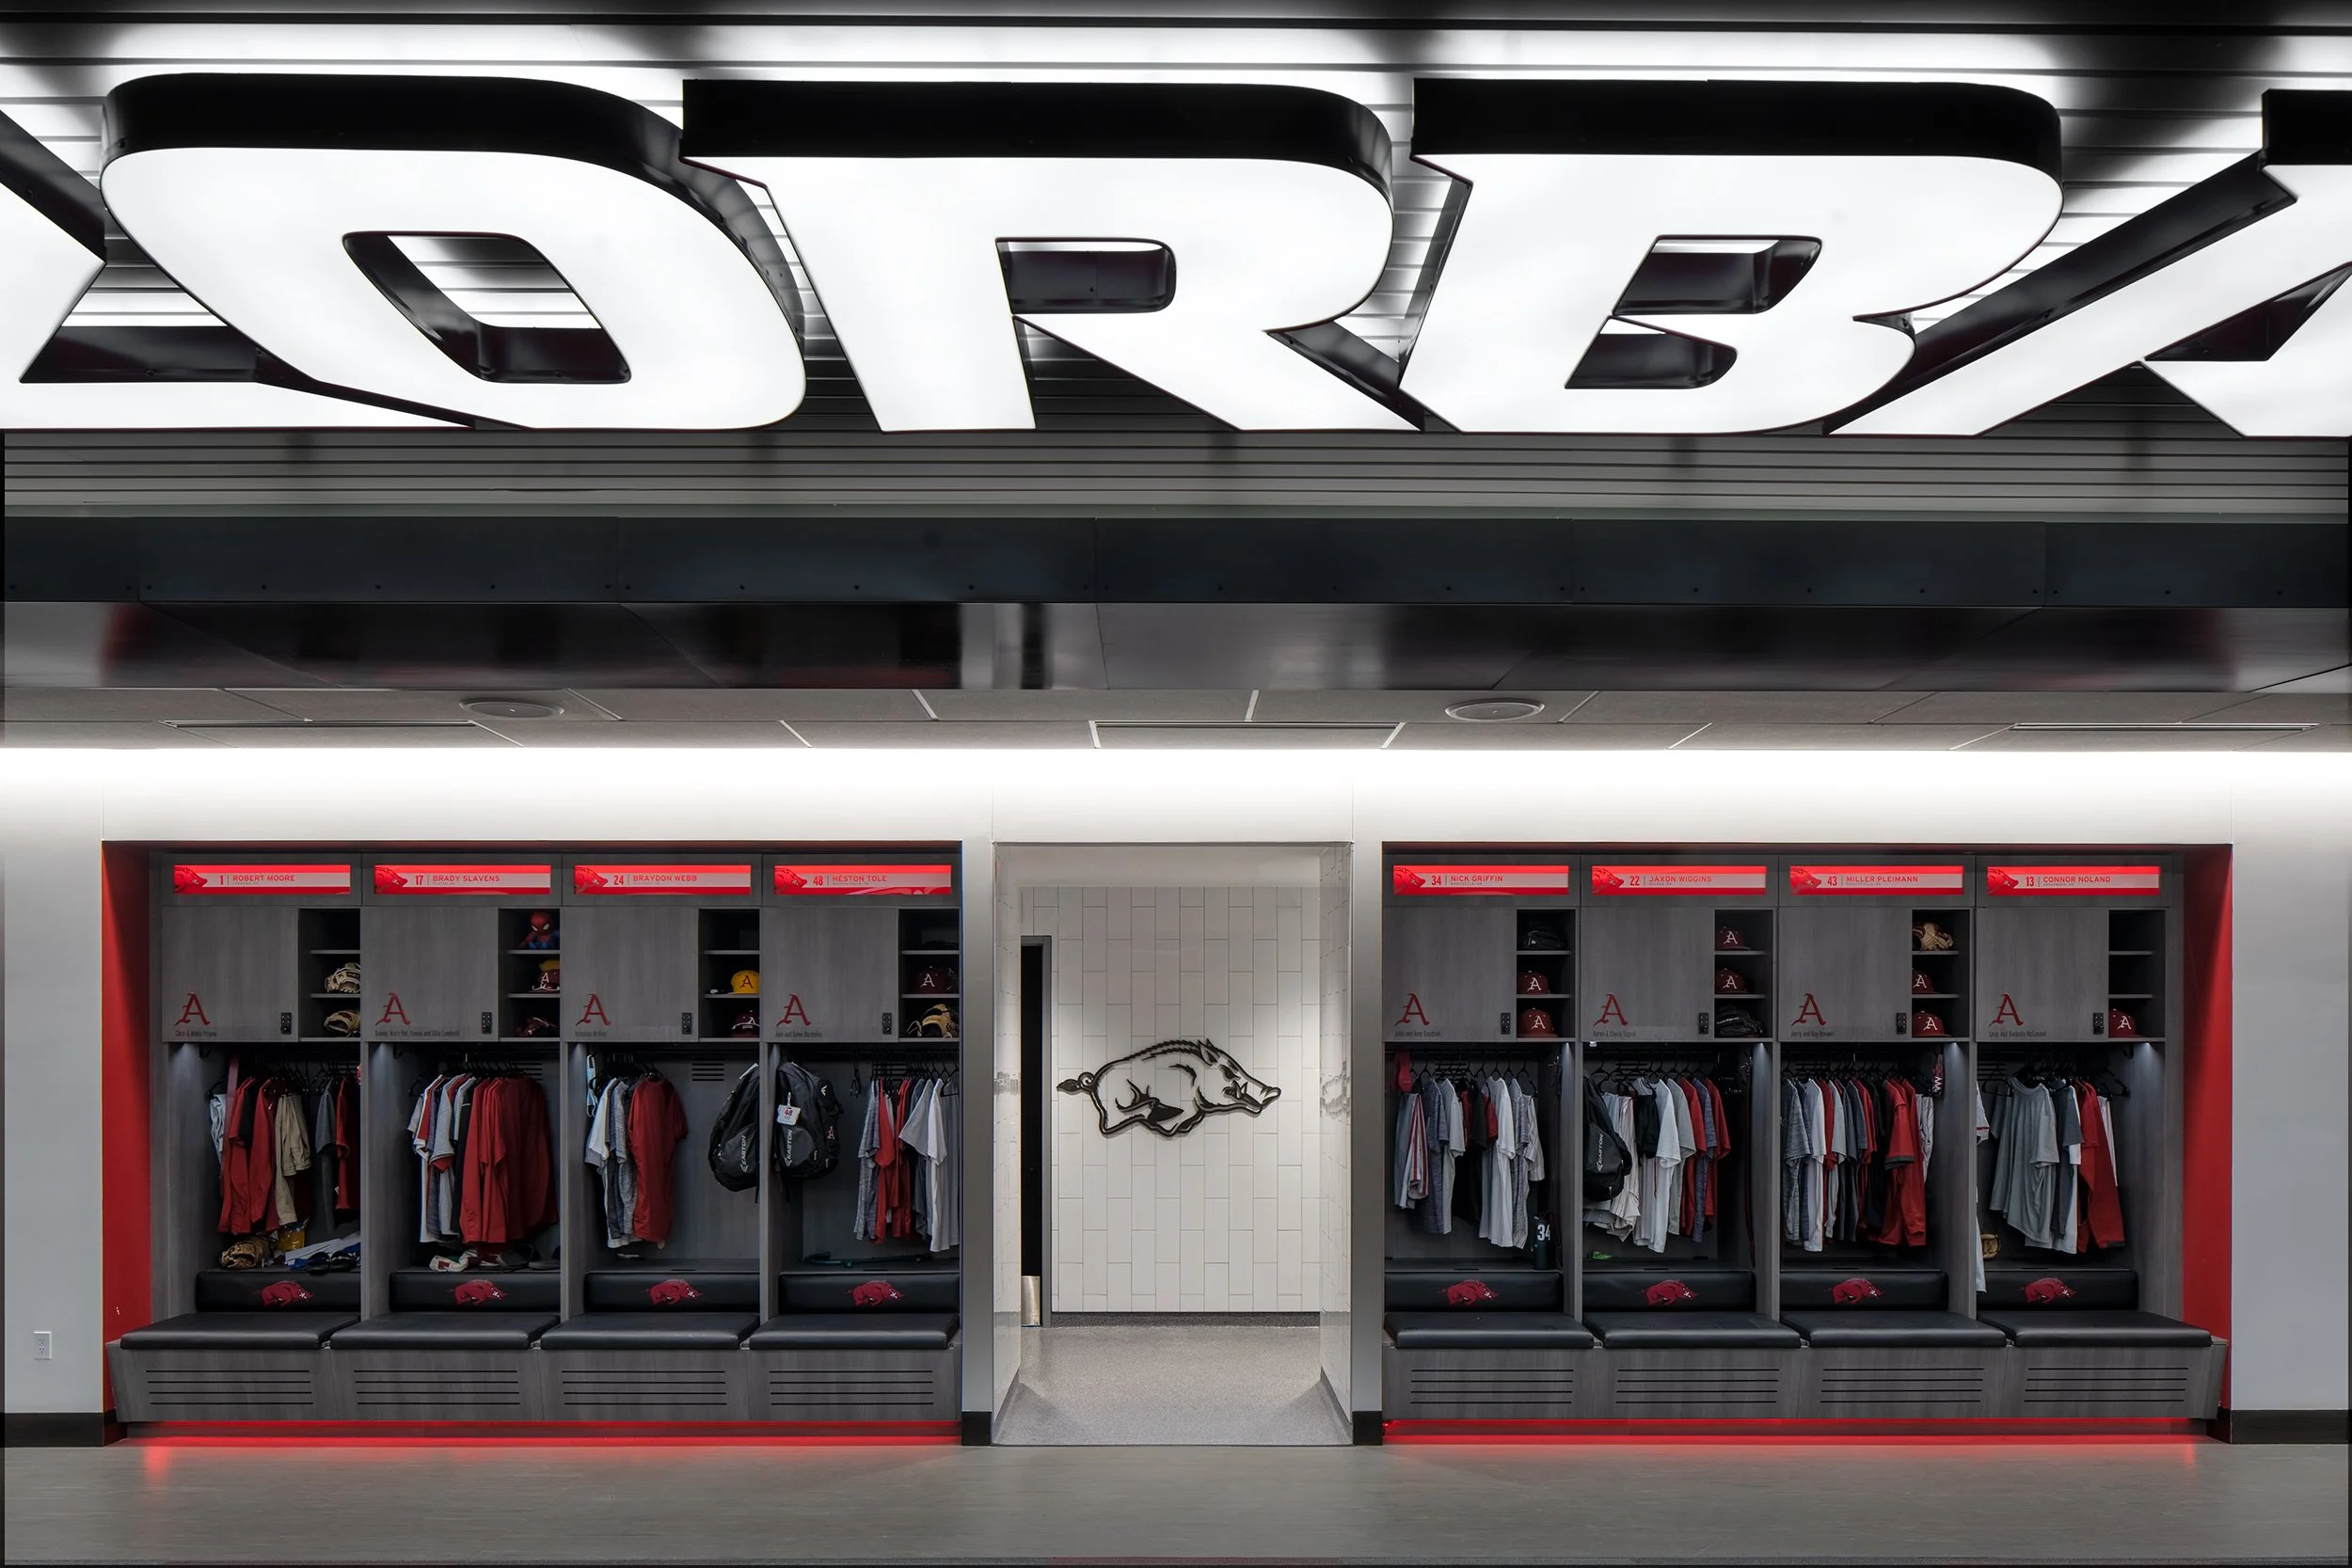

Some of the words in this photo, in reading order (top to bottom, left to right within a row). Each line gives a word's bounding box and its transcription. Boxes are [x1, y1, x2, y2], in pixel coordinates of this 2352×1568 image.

[219, 875, 224, 885] 1
[415, 875, 424, 885] 17
[613, 875, 624, 885] 24
[813, 875, 823, 886] 48
[1431, 875, 1441, 886] 34
[1629, 876, 1640, 886] 22
[1827, 876, 1837, 886] 43
[2026, 876, 2035, 887] 13
[1724, 930, 1739, 944] A
[739, 974, 755, 990] A
[920, 973, 935, 988] A
[1527, 977, 1542, 991] A
[1723, 974, 1738, 989] A
[1913, 974, 1928, 989] A
[174, 991, 211, 1026] A
[375, 991, 411, 1026] A
[575, 992, 612, 1027] A
[775, 992, 812, 1027] A
[1394, 992, 1431, 1026] A
[1593, 992, 1629, 1026] A
[1791, 992, 1827, 1027] A
[1988, 992, 2024, 1026] A
[1531, 1015, 1546, 1030] A
[1923, 1016, 1938, 1031] A
[2117, 1015, 2132, 1030] A
